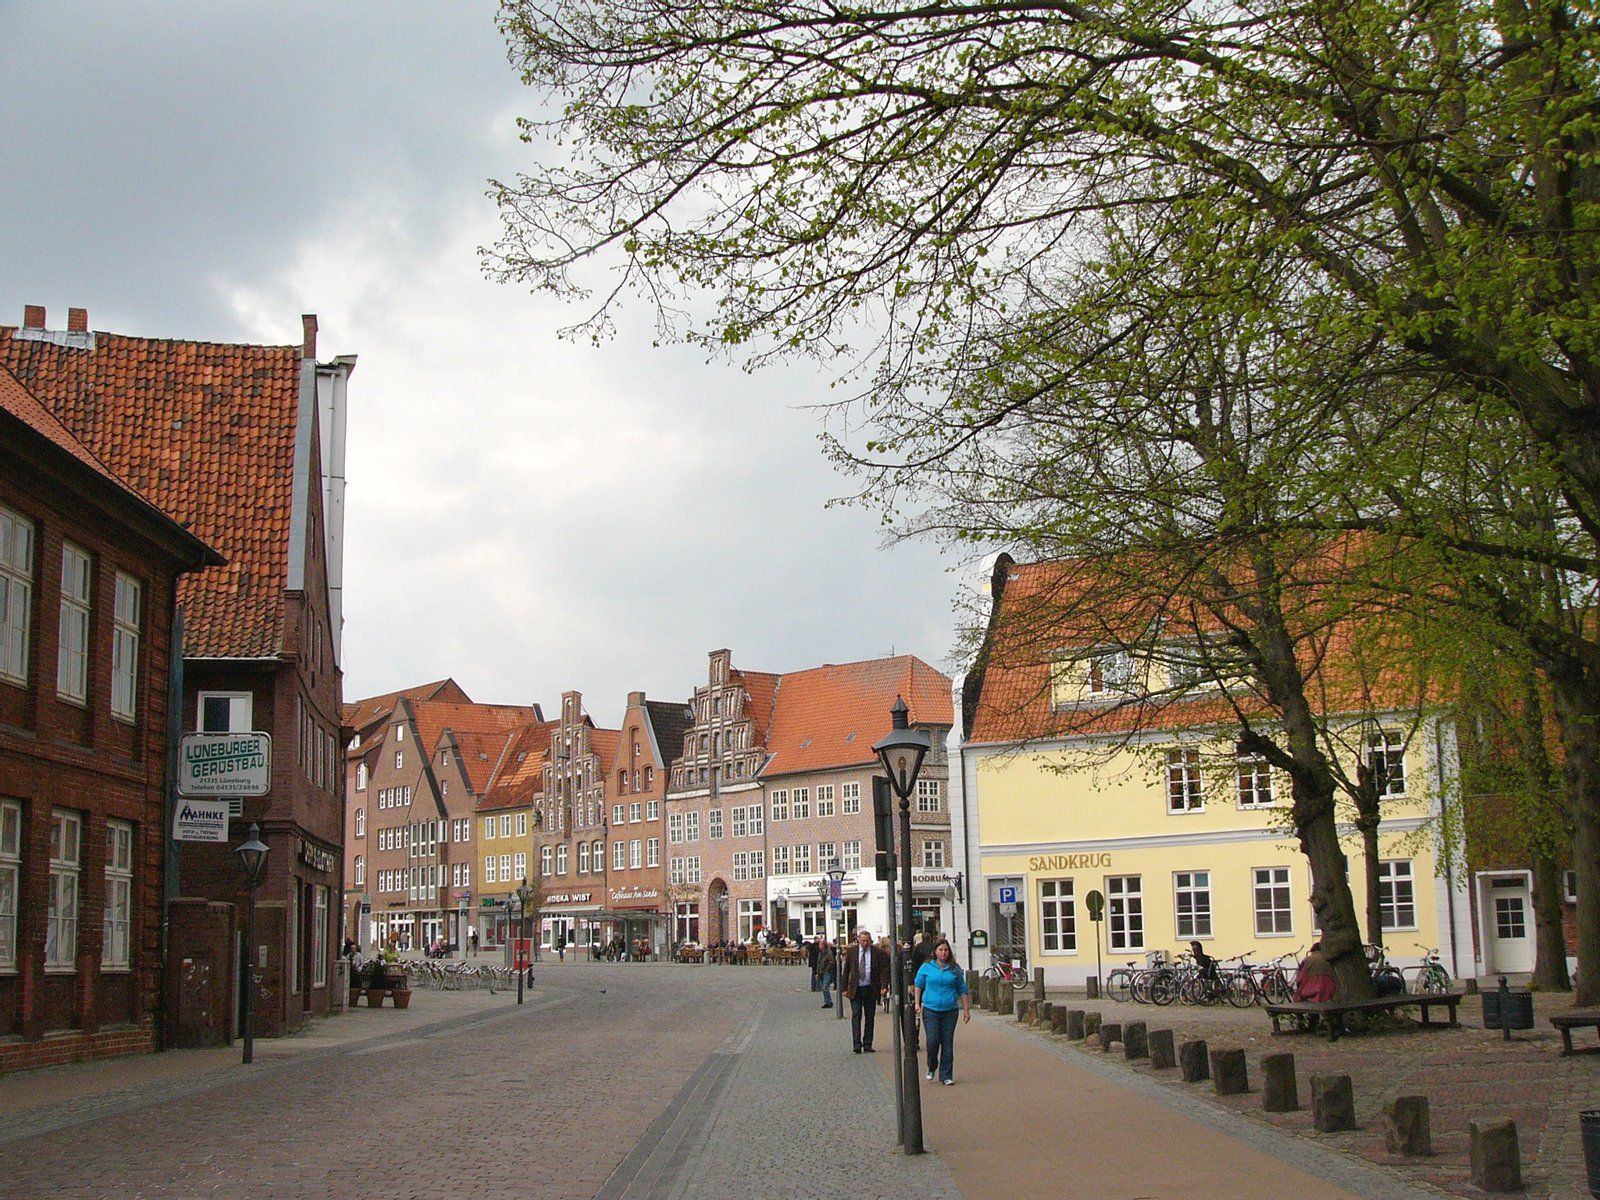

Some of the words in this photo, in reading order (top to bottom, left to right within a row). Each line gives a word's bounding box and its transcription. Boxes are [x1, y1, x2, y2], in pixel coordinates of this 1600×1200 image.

[187, 740, 260, 759] LÜNEBURGER
[192, 756, 264, 778] GERÜSTBAU
[180, 805, 224, 820] MAHNKE
[1029, 853, 1112, 871] SANDKRUG
[912, 874, 949, 883] BODRUM
[571, 893, 591, 902] WIST
[1002, 888, 1012, 902] P
